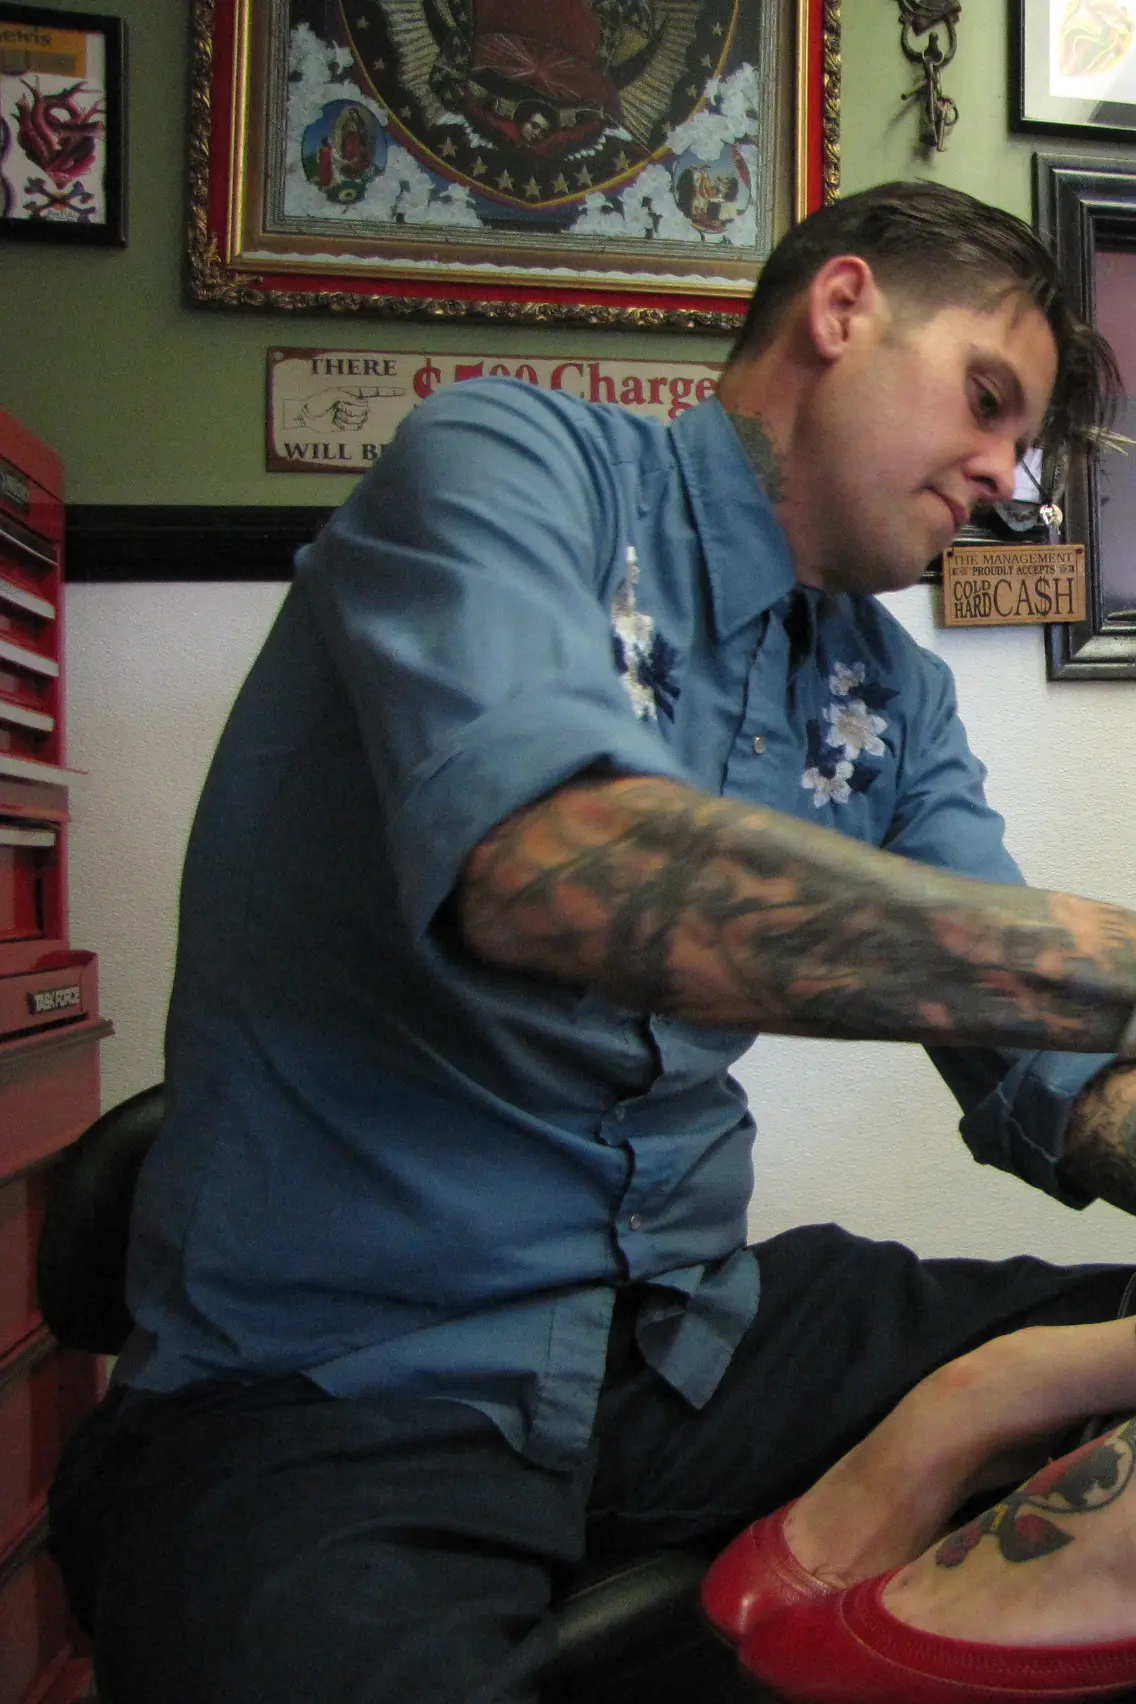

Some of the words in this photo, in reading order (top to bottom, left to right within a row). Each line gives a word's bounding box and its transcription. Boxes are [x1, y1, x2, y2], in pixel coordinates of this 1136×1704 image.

[311, 358, 397, 376] THERE
[550, 362, 718, 420] Charge
[283, 442, 352, 460] WILL
[362, 443, 385, 460] B
[954, 556, 978, 566] THE
[983, 552, 1073, 566] MANAGEMENT
[972, 565, 1014, 577] PROUDLY
[1016, 564, 1056, 575] ACCEPTS
[953, 580, 991, 601] COLD
[954, 592, 992, 619] HARD
